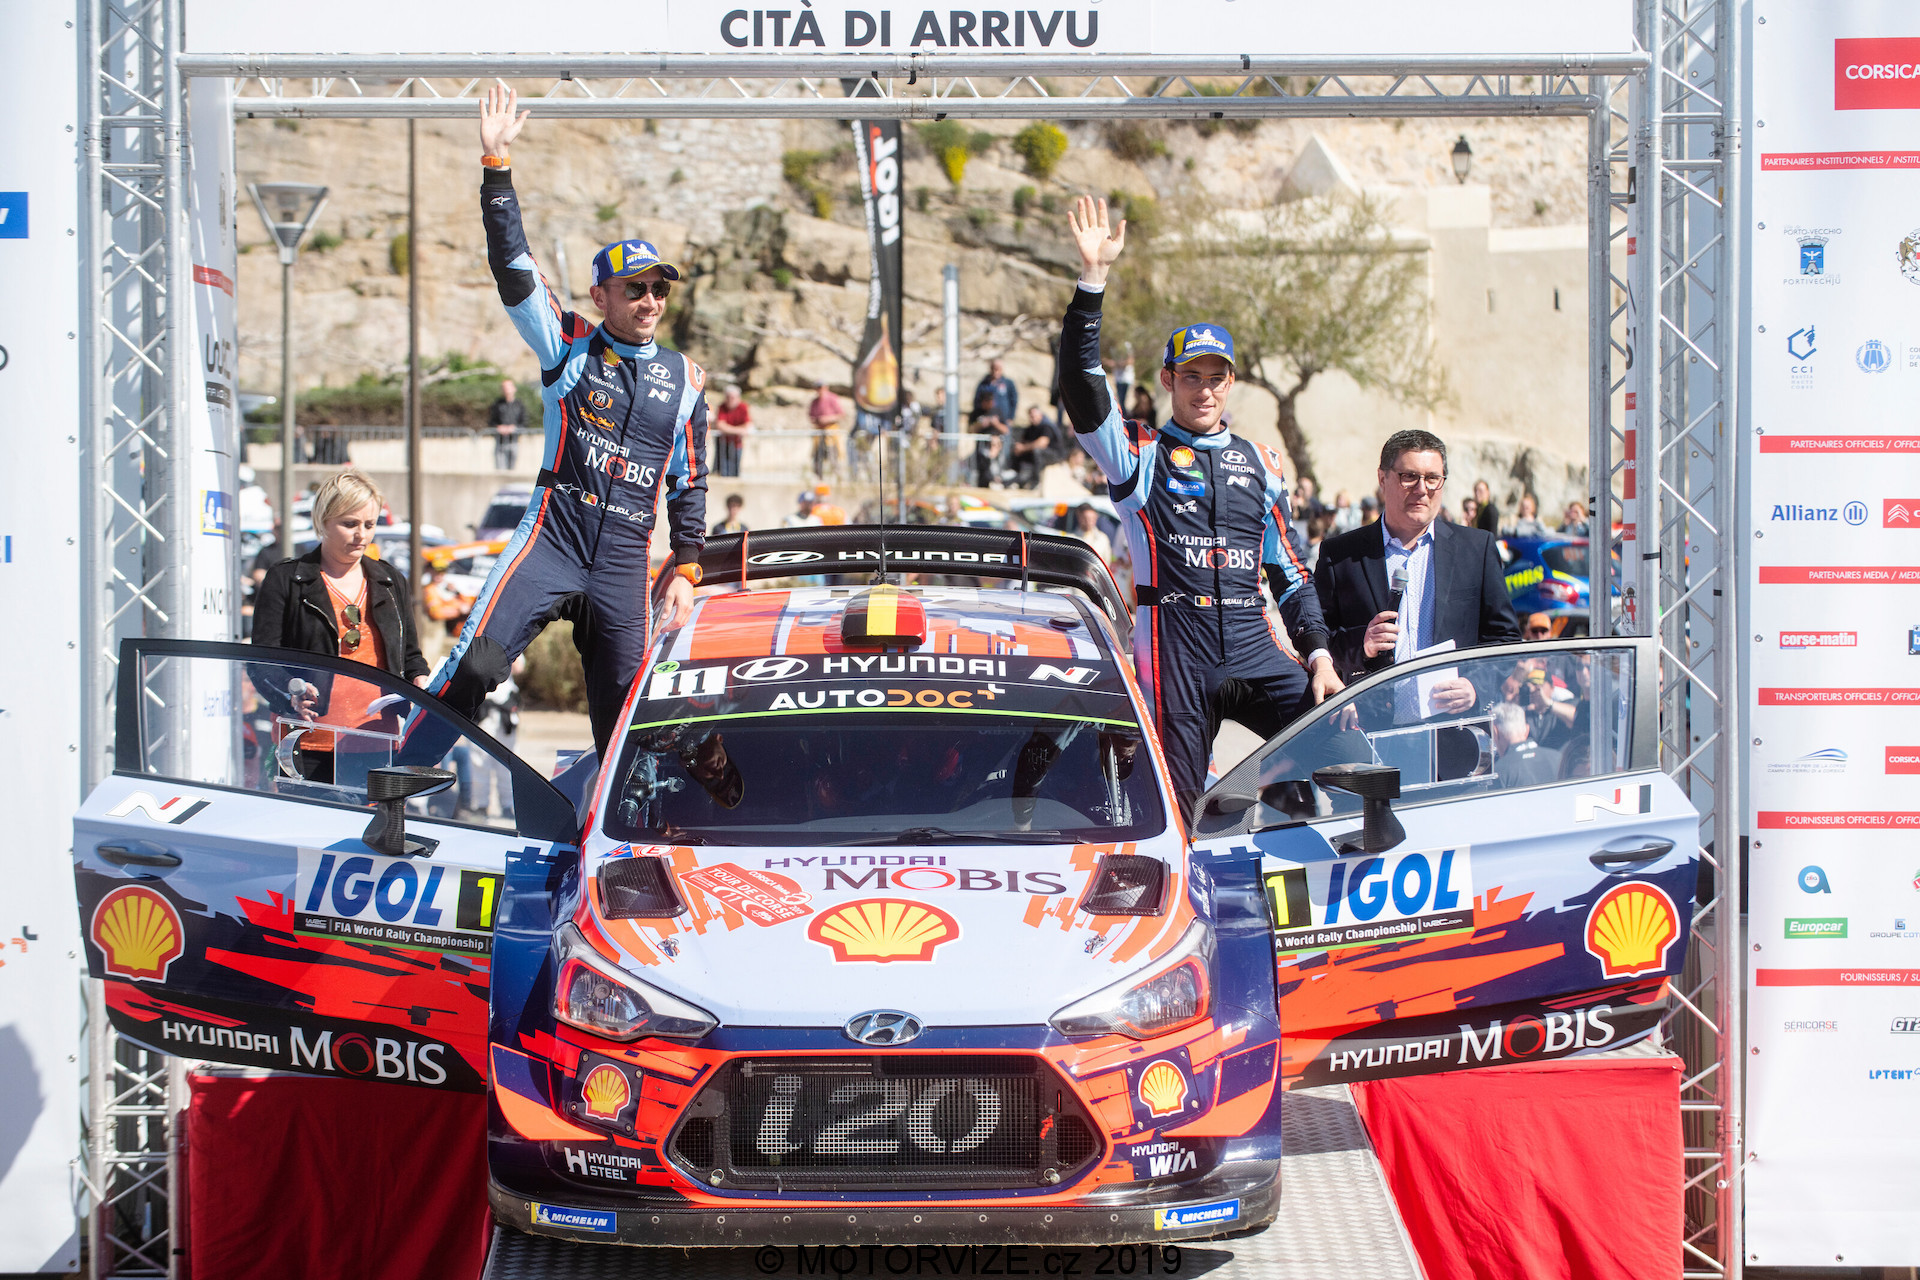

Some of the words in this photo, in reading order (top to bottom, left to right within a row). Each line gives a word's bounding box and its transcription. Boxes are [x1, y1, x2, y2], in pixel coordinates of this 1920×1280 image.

[720, 0, 826, 48] CITÀ
[844, 10, 891, 47] DI
[910, 9, 1099, 48] ARRIVU
[1764, 158, 1814, 166] PARTENAIRES
[1816, 156, 1884, 165] INSTITUTIONNELS
[1185, 340, 1226, 350] MICHELIN
[1791, 366, 1813, 374] CCI
[588, 373, 624, 394] Wallonia.be
[644, 374, 676, 390] HYUNDAI
[577, 427, 630, 458] HYUNDAI
[1790, 440, 1843, 448] PARTENAIRES
[1845, 440, 1884, 448] OFFICIELS
[584, 446, 656, 488] MOBIS
[1220, 462, 1256, 474] HYUNDAI
[1771, 504, 1838, 520] Allianz
[1168, 534, 1226, 546] HYUNDAI
[838, 550, 1020, 564] HYUNDAI
[1185, 548, 1255, 570] MOBIS
[1809, 571, 1862, 580] PARTENAIRES
[1863, 571, 1890, 580] MEDIA
[1782, 632, 1855, 645] corse-matin
[823, 656, 1006, 677] HYUNDAI
[668, 670, 706, 696] 11
[768, 689, 974, 710] AUTODOC
[1775, 692, 1842, 700] TRANSPORTEURS
[1844, 692, 1882, 700] OFFICIELS
[1786, 816, 1845, 824] FOURNISSEURS
[1847, 816, 1885, 824] OFFICIELS
[765, 856, 946, 868] HYUNDAI
[748, 870, 777, 886] CORSICA
[823, 867, 1067, 895] MOBIS
[305, 854, 445, 926] IGOL
[477, 876, 496, 928] 1
[708, 868, 742, 885] TOUR
[738, 884, 756, 896] DE
[754, 894, 796, 919] CORSE
[1266, 875, 1289, 926] 1
[1324, 850, 1460, 925] IGOL
[722, 892, 743, 902] 11
[1285, 934, 1314, 947] World
[1317, 931, 1343, 944] Rally
[1346, 922, 1416, 940] Championship
[1790, 922, 1843, 934] Europcar
[334, 922, 352, 933] FIA
[354, 924, 383, 938] World
[386, 928, 412, 943] Rally
[414, 932, 484, 951] Championship
[1840, 973, 1901, 982] FOURNISSEURS
[1784, 1020, 1838, 1030] SÉRICORSE
[1329, 1038, 1450, 1072] HYUNDAI
[1456, 1004, 1616, 1065] MOBIS
[162, 1020, 280, 1054] HYUNDAI
[290, 1026, 448, 1085] MOBIS
[1869, 1070, 1913, 1080] LPTENT
[1132, 1142, 1179, 1157] HYUNDAI
[588, 1152, 642, 1169] HYUNDAI
[590, 1165, 628, 1180] STEEL
[552, 1213, 608, 1226] MICHELIN
[1181, 1206, 1234, 1223] MICHELIN
